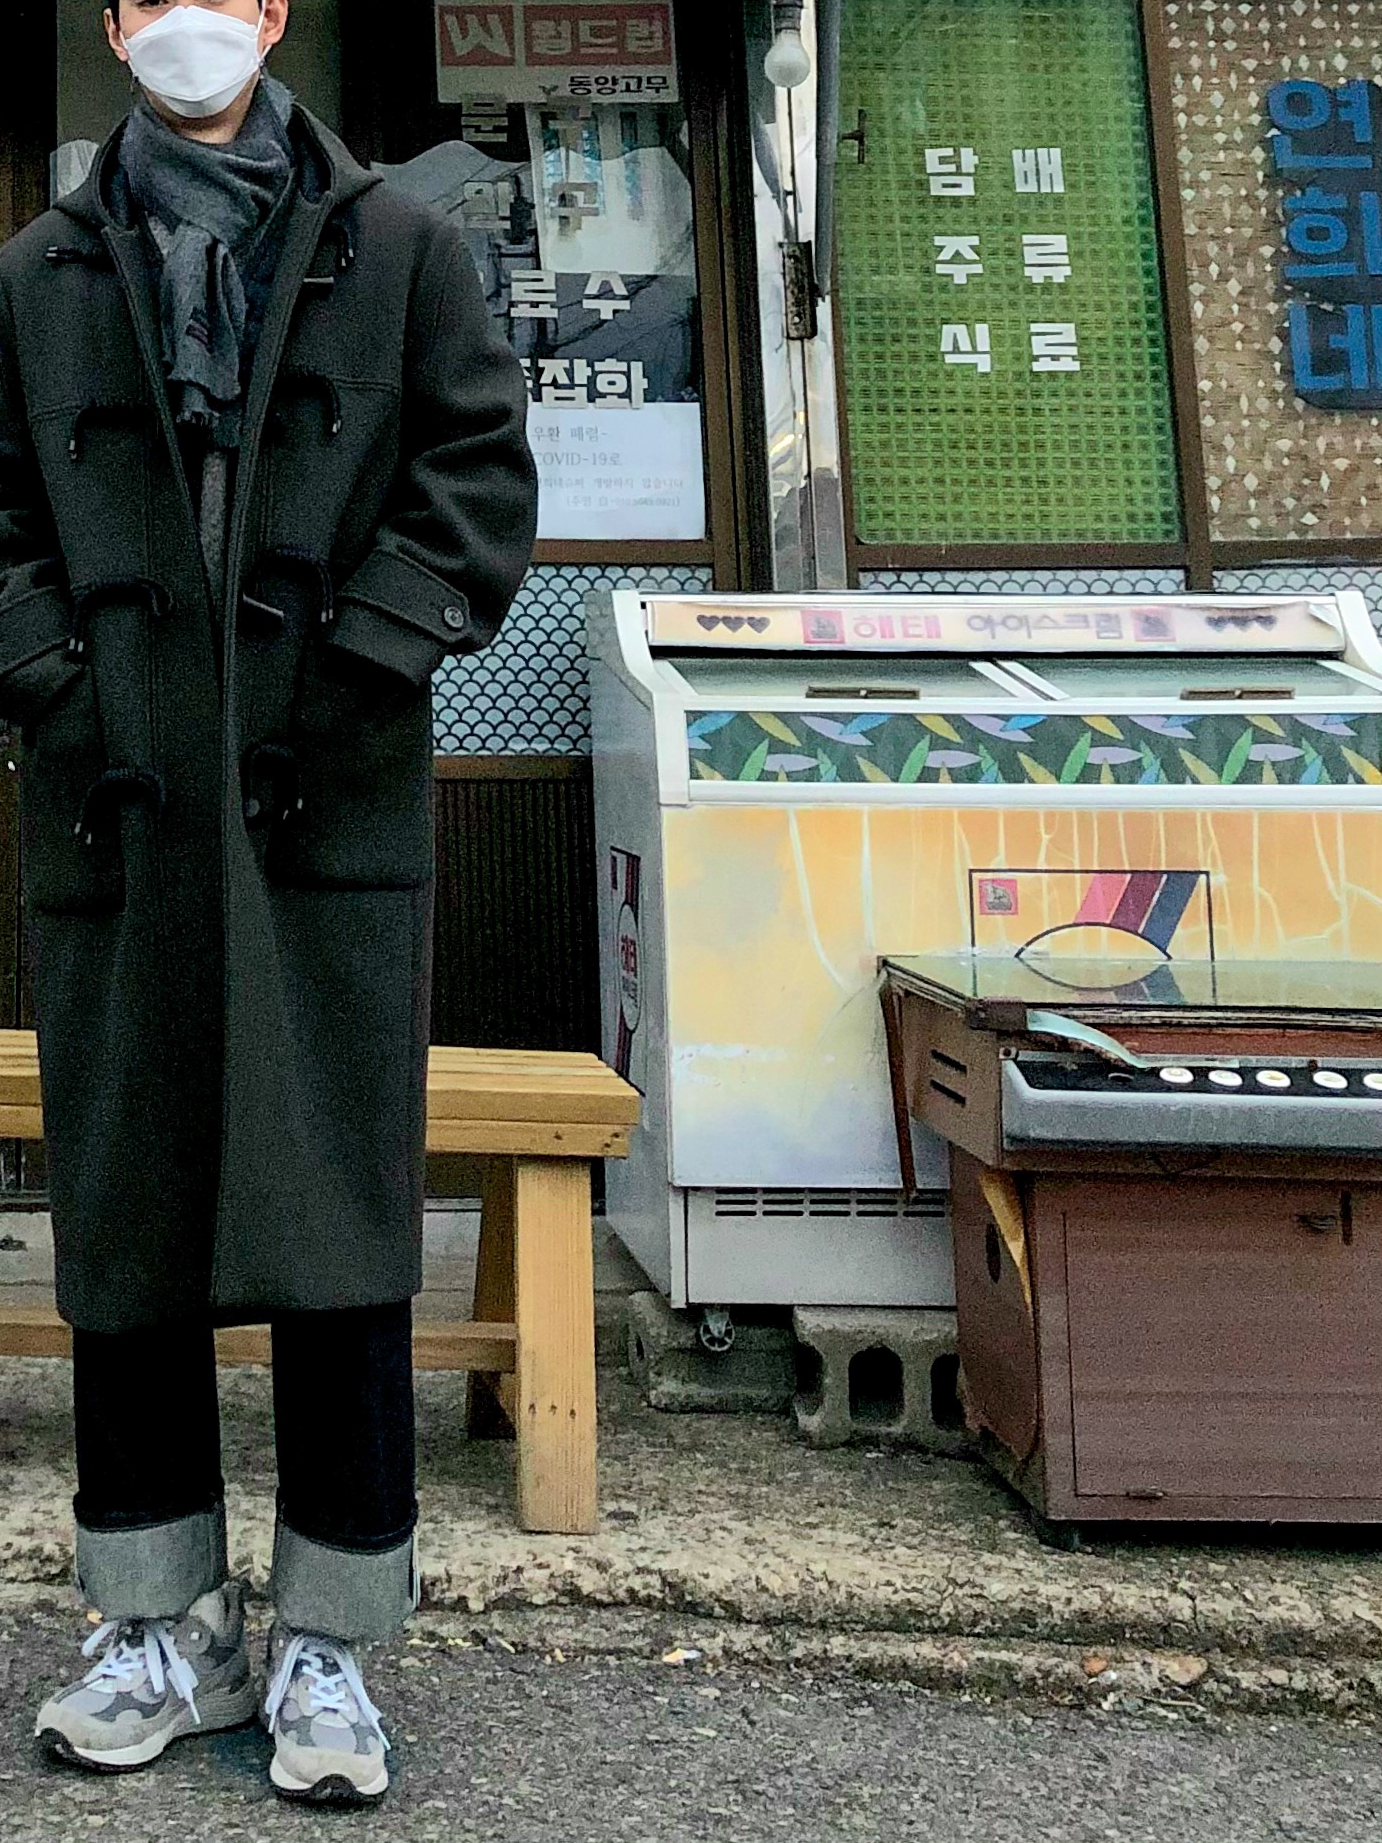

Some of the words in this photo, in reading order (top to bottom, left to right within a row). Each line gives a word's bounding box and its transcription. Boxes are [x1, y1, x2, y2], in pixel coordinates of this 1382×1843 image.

[567, 74, 669, 96] 동양고무
[519, 358, 650, 409] 잡화
[853, 614, 942, 639] 해태
[966, 613, 1123, 640] 아이스크림
